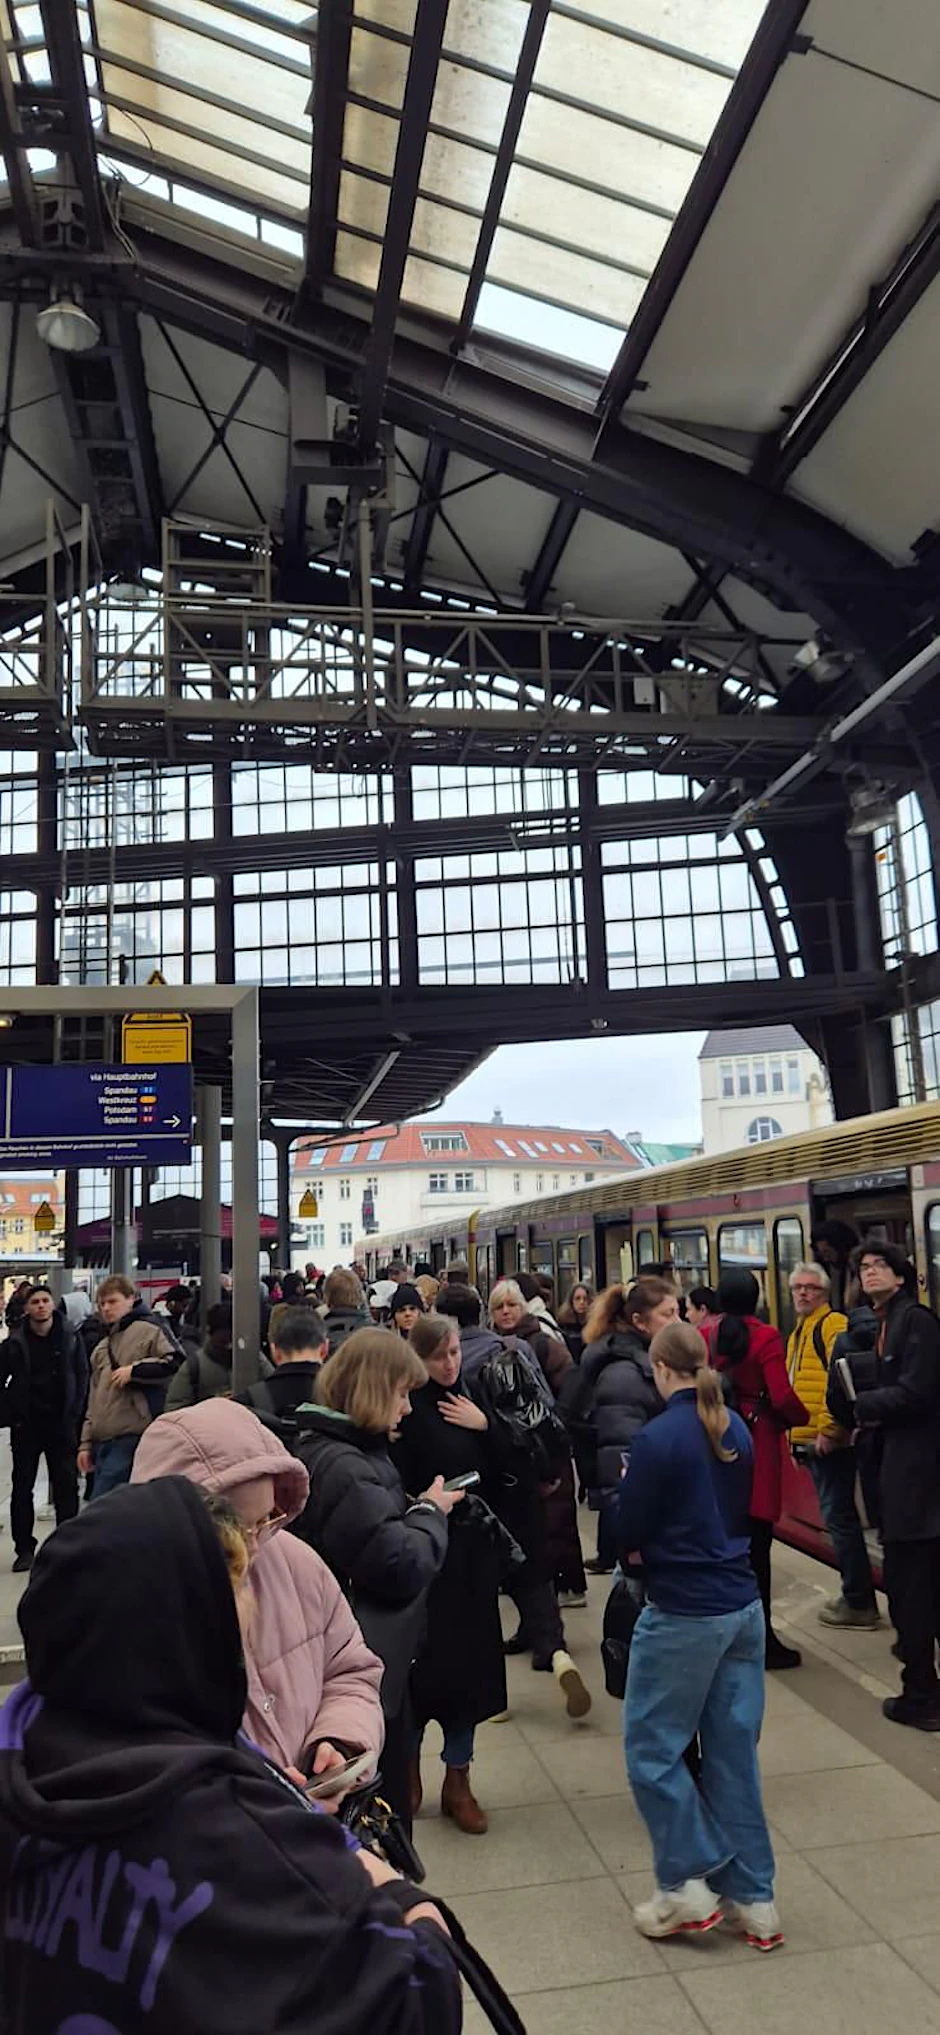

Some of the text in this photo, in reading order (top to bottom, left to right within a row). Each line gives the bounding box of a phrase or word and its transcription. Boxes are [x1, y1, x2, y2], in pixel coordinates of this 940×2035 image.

[103, 1072, 157, 1081] Hauptbahnhof
[104, 1087, 138, 1095] Spandau
[104, 1106, 138, 1114] Potsdam
[104, 1116, 138, 1125] Spandau
